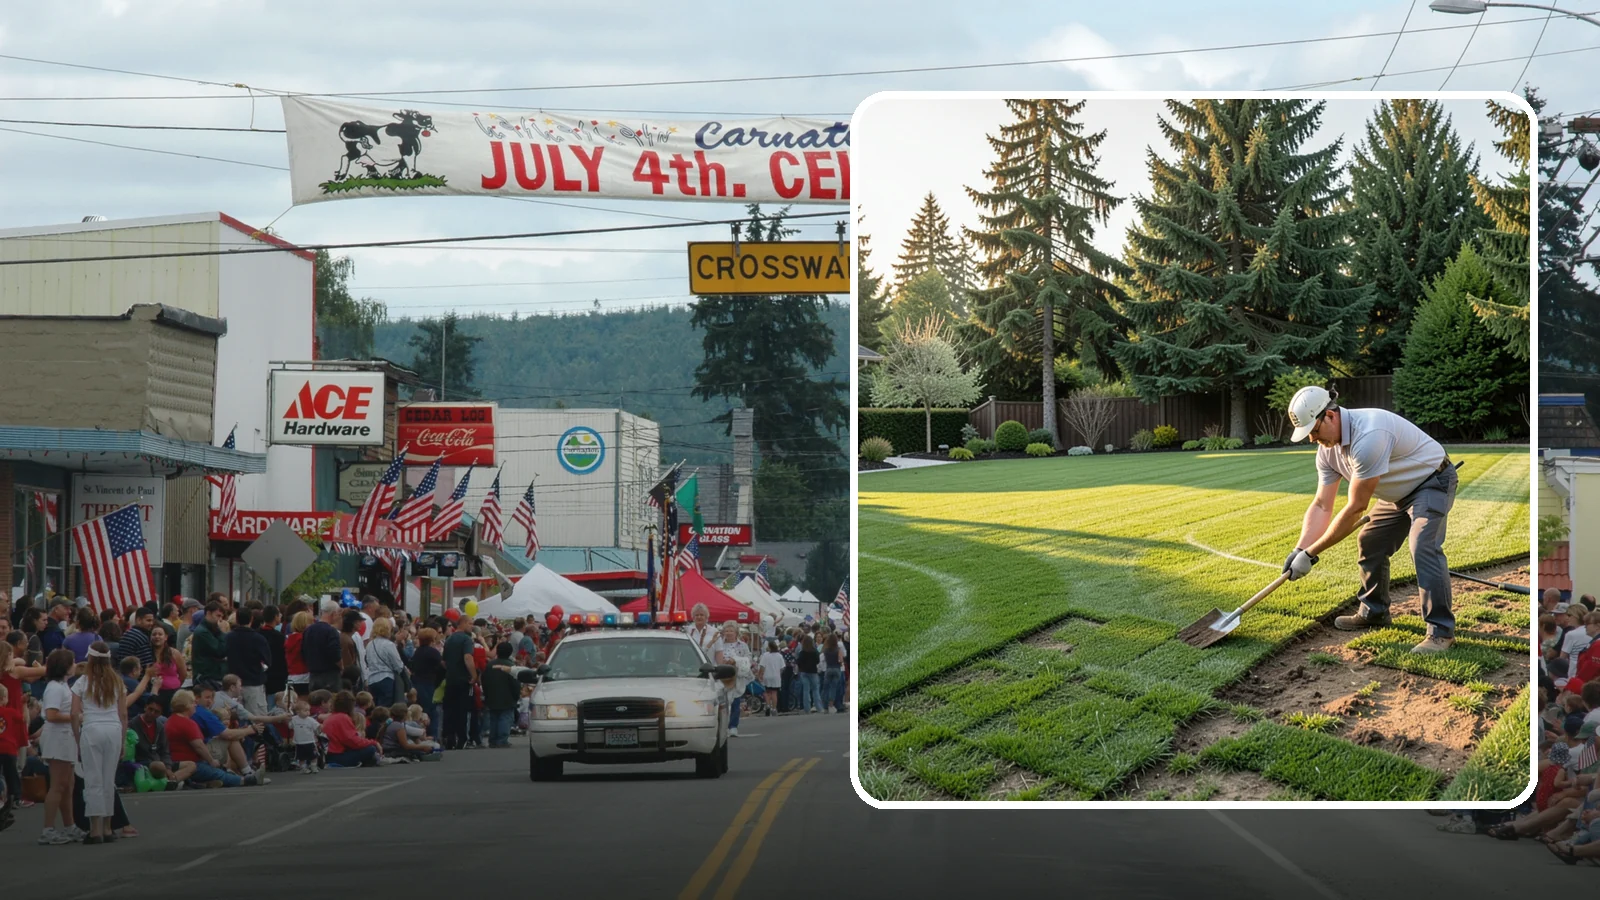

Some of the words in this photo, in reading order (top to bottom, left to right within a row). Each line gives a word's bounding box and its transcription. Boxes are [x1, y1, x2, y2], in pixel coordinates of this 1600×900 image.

[481, 141, 604, 192] JULY
[632, 150, 746, 197] 4th.
[697, 254, 850, 280] CROSSWA
[283, 380, 373, 419] ACE
[406, 409, 452, 422] CEDAR
[461, 409, 485, 422] LOG
[284, 421, 370, 436] Hardware
[416, 428, 476, 447] Coca-Cola
[353, 467, 386, 481] Simpl
[96, 485, 124, 494] Vincent
[126, 486, 135, 494] de
[138, 486, 155, 495] Paul
[688, 527, 741, 535] CRNATION
[699, 535, 730, 543] GLASS
